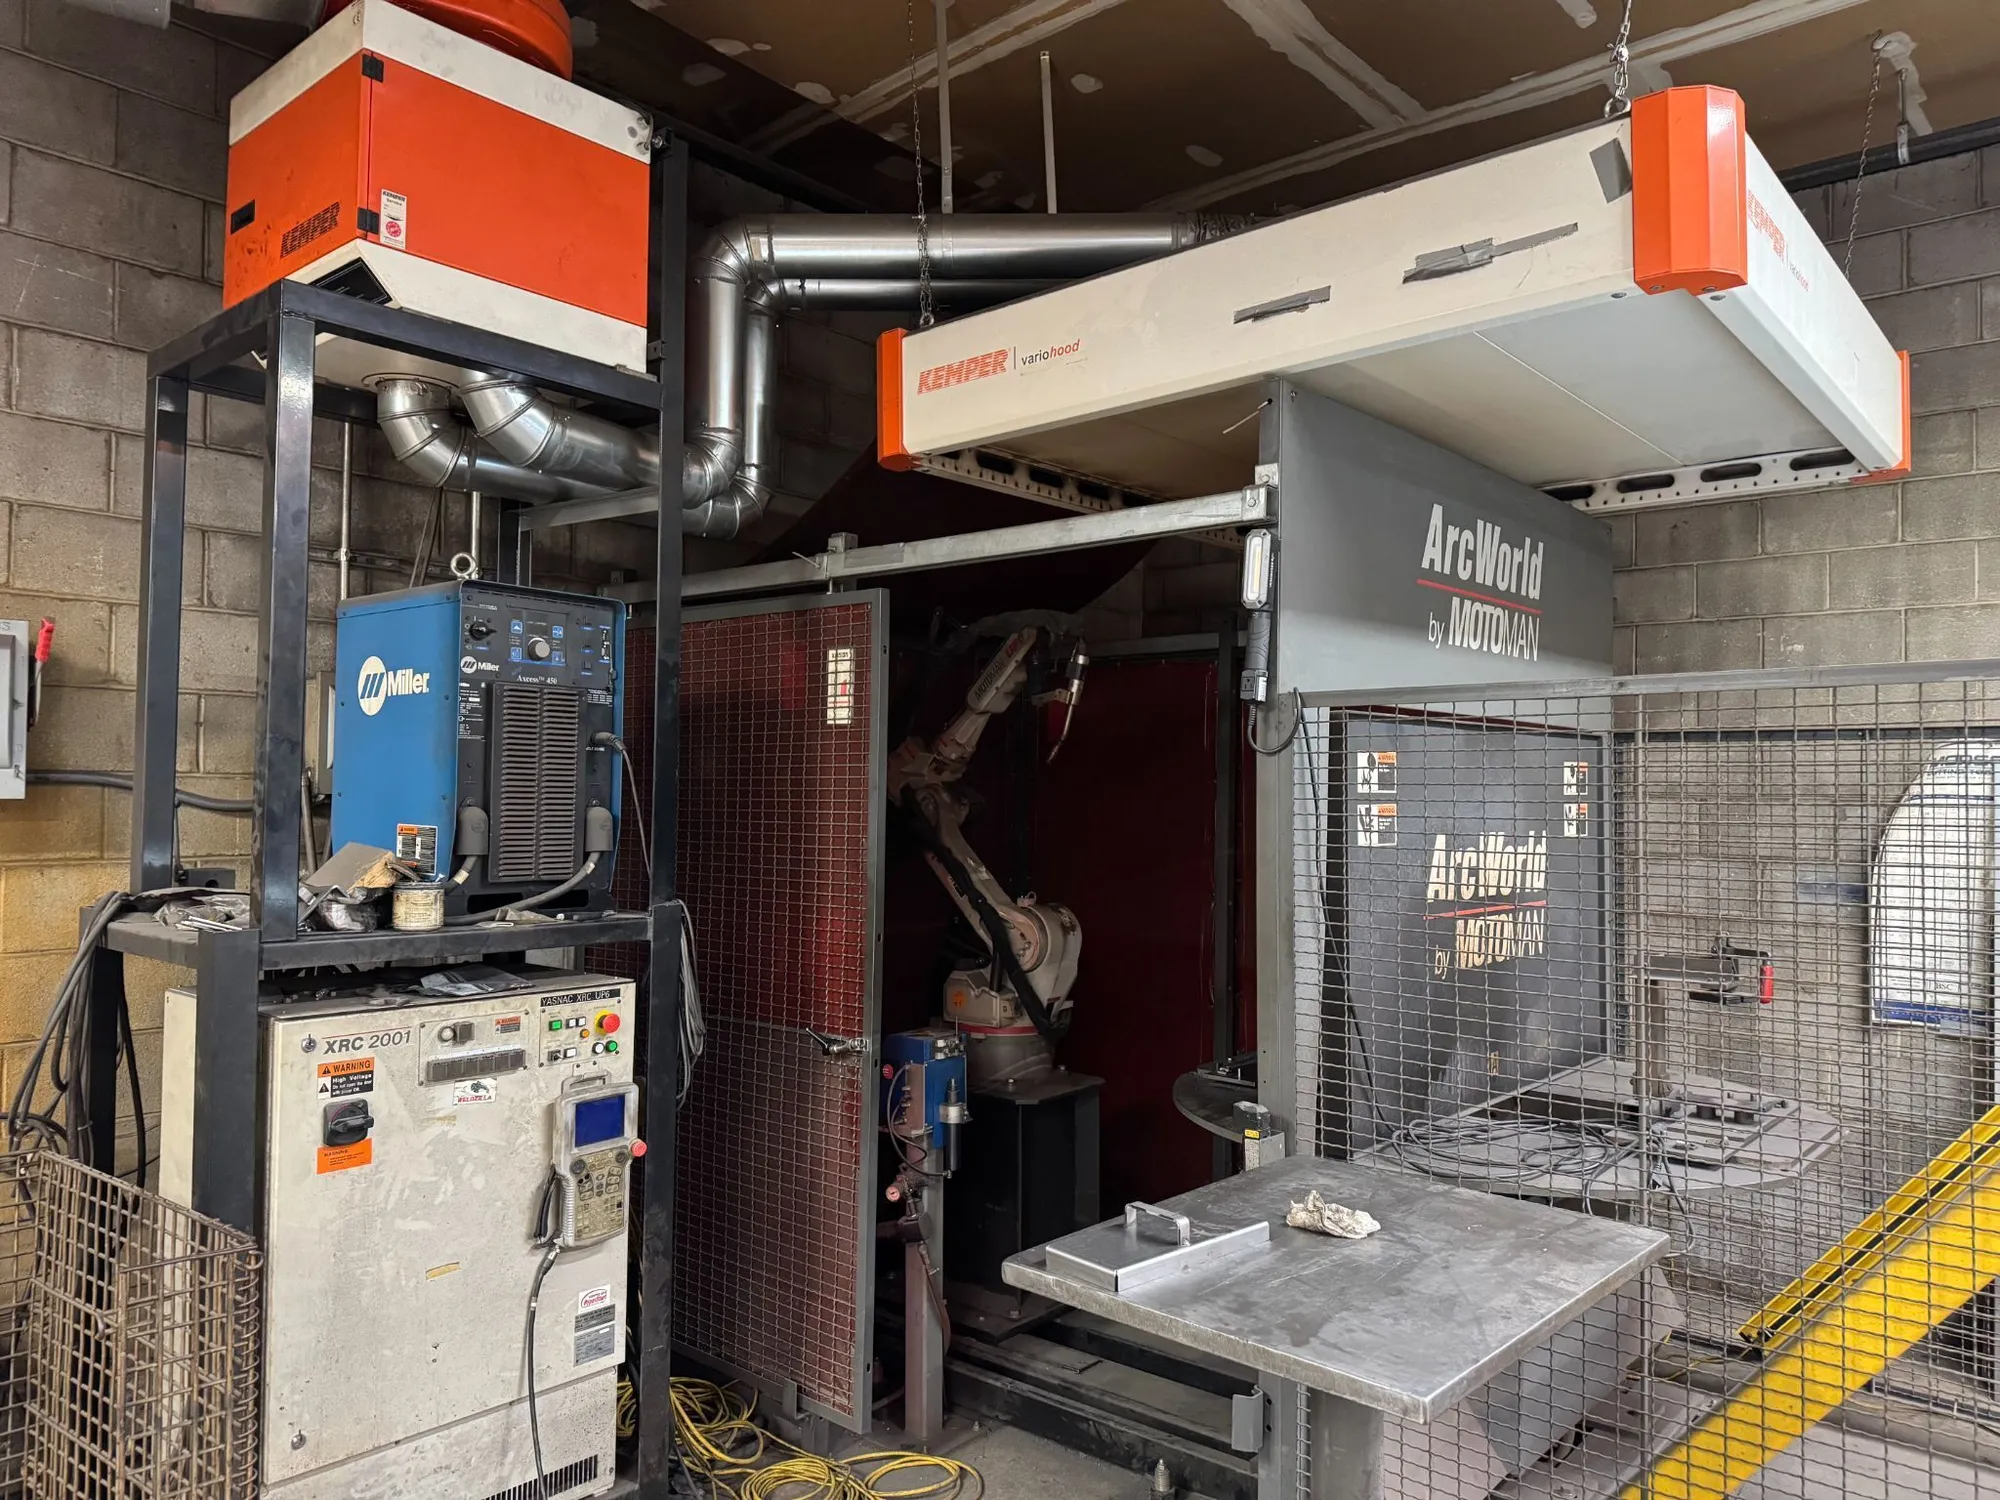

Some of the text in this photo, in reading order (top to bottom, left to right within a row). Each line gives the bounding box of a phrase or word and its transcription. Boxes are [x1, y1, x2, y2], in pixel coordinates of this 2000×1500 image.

[917, 338, 1081, 395] KEMPER variohood
[1421, 503, 1544, 600] ArcWorld
[1428, 596, 1540, 662] by MOTOMAN
[477, 661, 500, 672] Miller
[387, 668, 430, 697] Miller
[546, 677, 558, 685] 450
[1427, 831, 1547, 903] ArcWorld
[1434, 909, 1544, 980] by MOTOMAN
[542, 990, 611, 1006] YASNAC XRC UP6
[323, 1030, 411, 1055] XRC 2001
[333, 1060, 371, 1073] WARNING
[349, 1073, 372, 1081] Voltage
